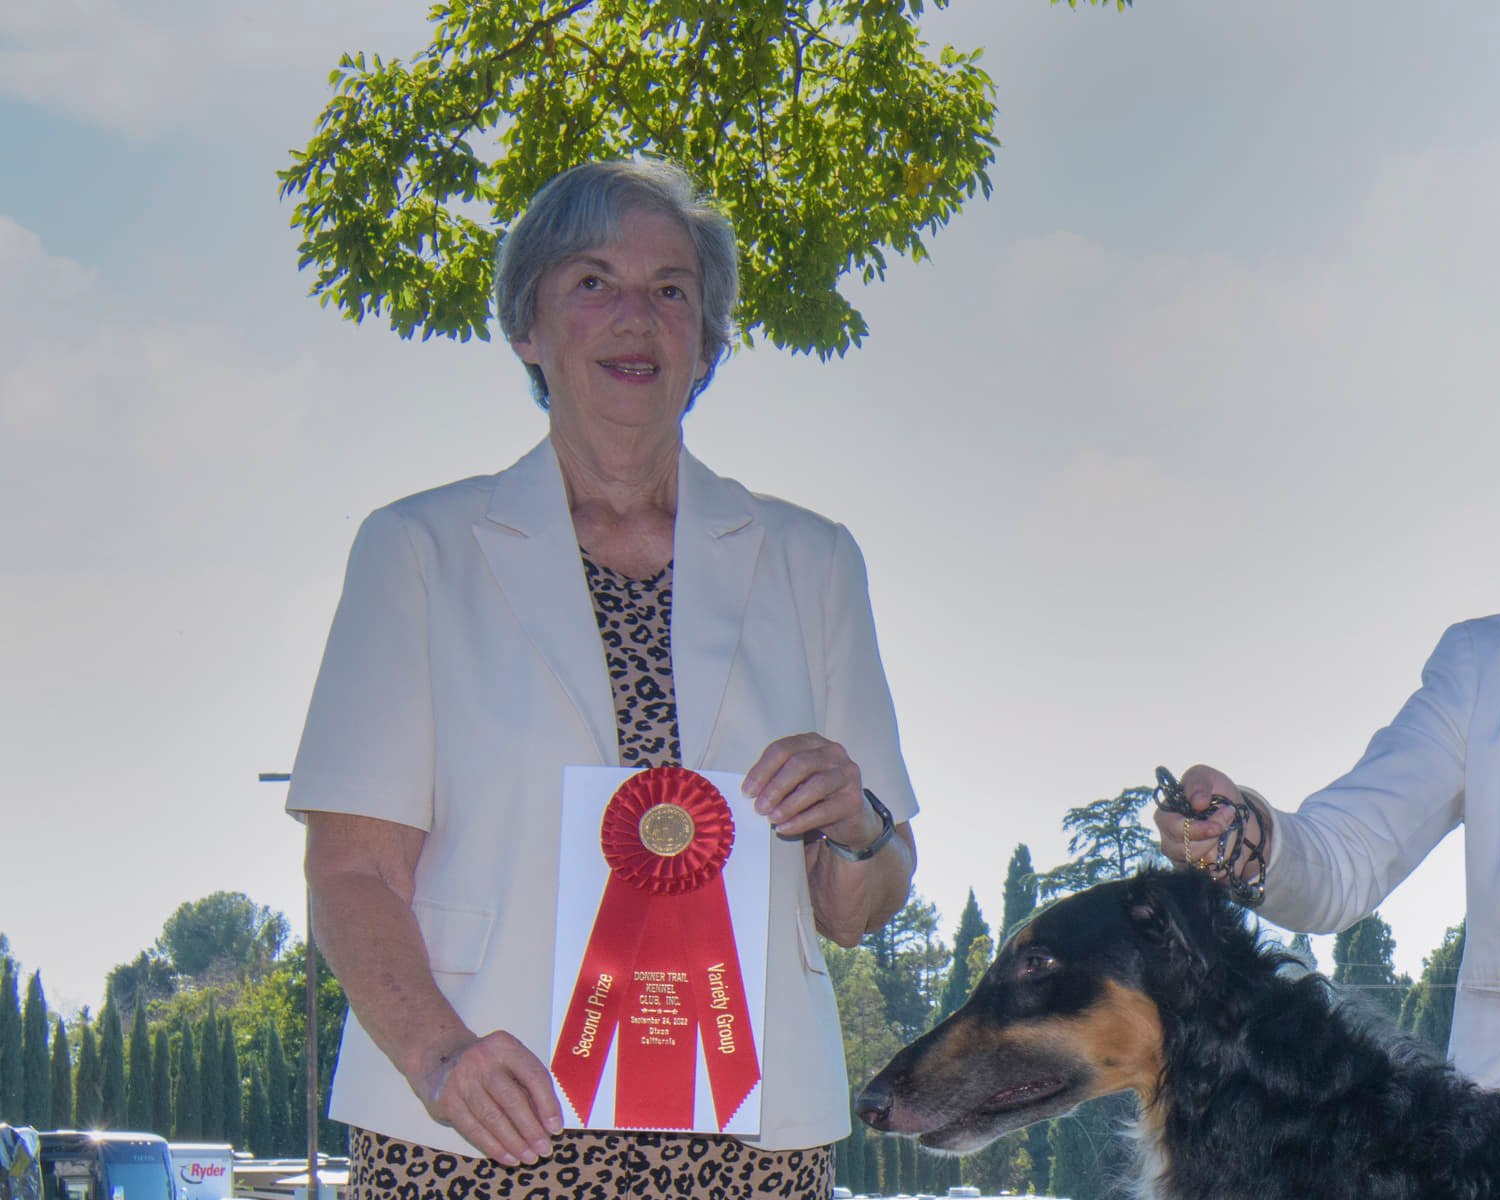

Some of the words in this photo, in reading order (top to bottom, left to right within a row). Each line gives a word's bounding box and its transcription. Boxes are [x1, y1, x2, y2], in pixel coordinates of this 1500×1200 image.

[633, 971, 666, 982] DONNER
[667, 972, 689, 983] TRAIL
[646, 983, 676, 994] KENNEL
[707, 962, 730, 1011] Variety
[572, 1008, 602, 1058] Second
[587, 973, 613, 1008] Prize
[630, 1015, 660, 1024] September
[716, 1012, 736, 1055] Group
[640, 1036, 676, 1046] California
[191, 1163, 226, 1180] Ryder
